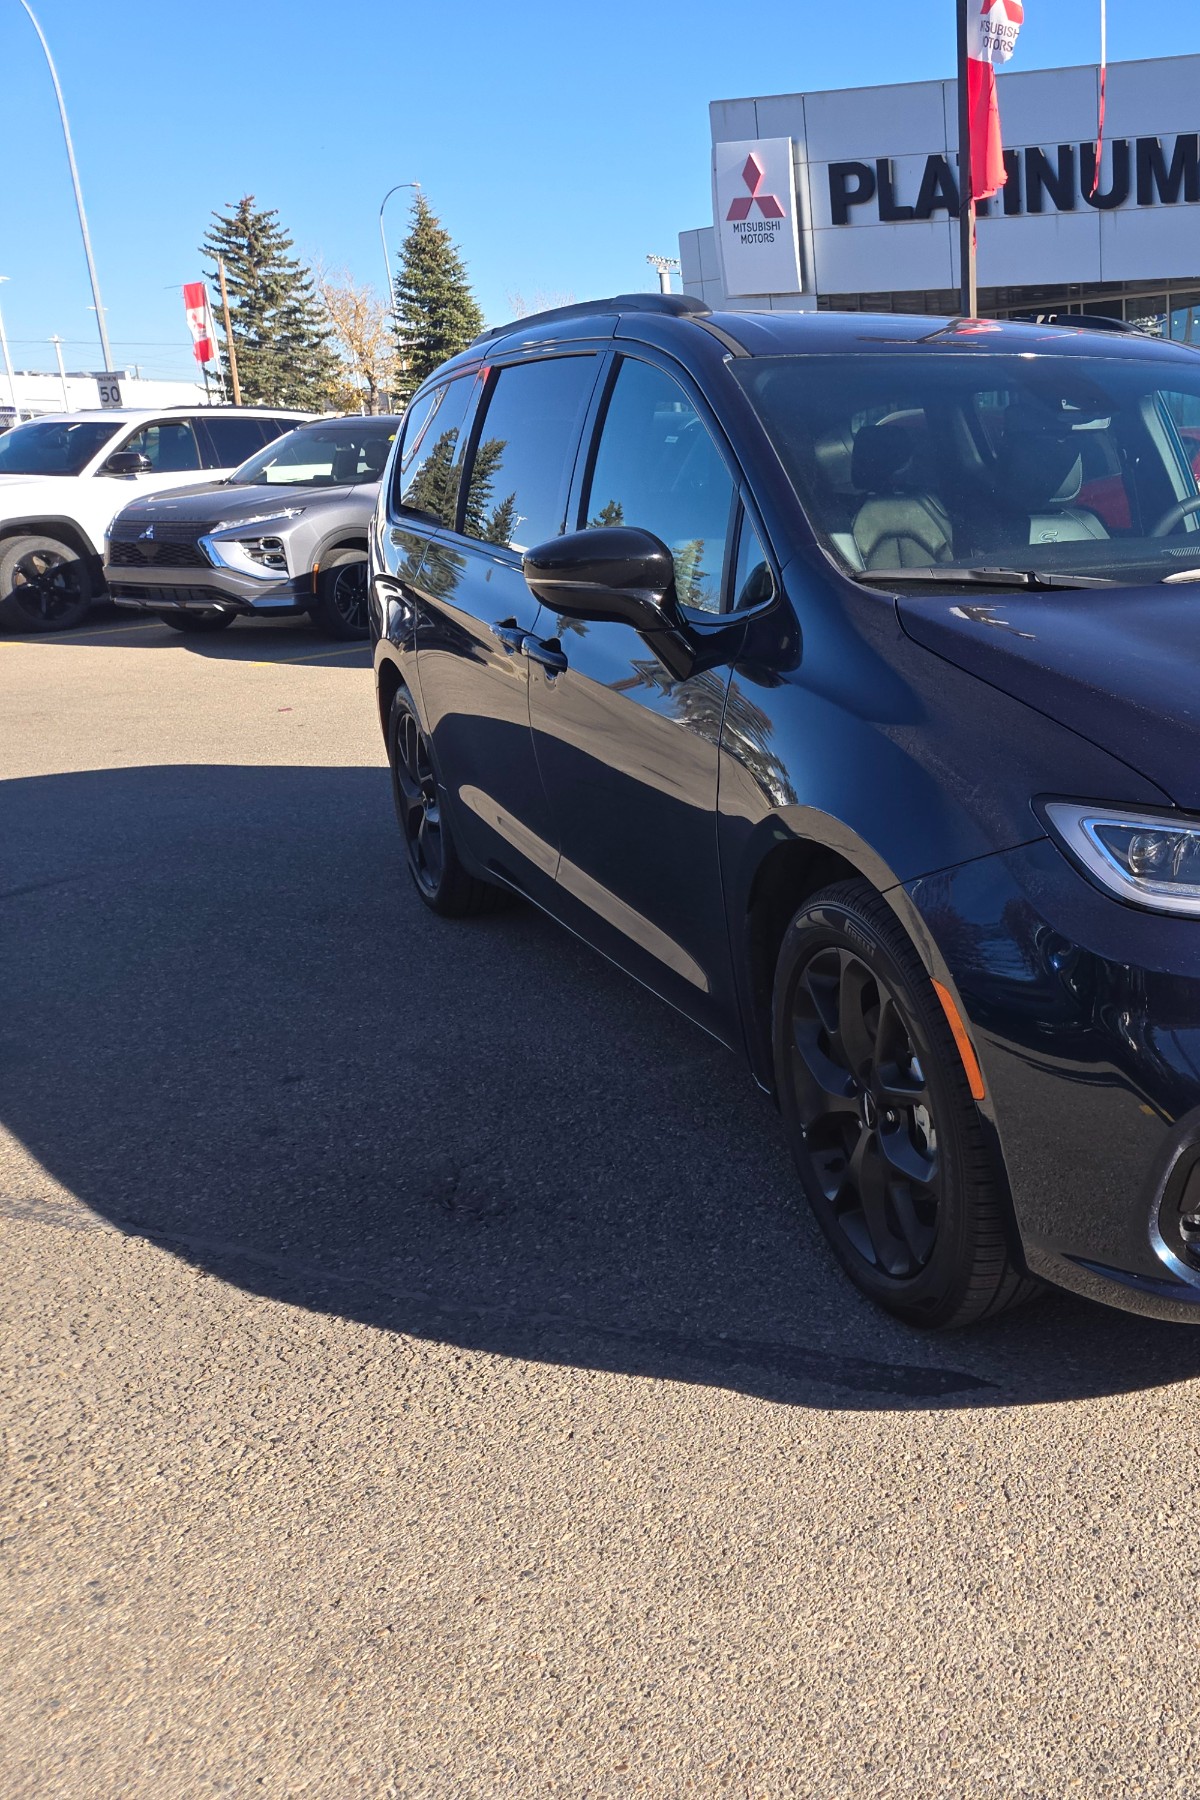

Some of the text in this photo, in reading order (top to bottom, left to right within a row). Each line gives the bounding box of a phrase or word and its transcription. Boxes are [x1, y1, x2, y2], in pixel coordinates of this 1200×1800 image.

[983, 36, 1014, 52] OTORS
[733, 221, 781, 233] MITSUBISHI
[741, 233, 775, 244] MOTORS
[100, 386, 121, 403] 50
